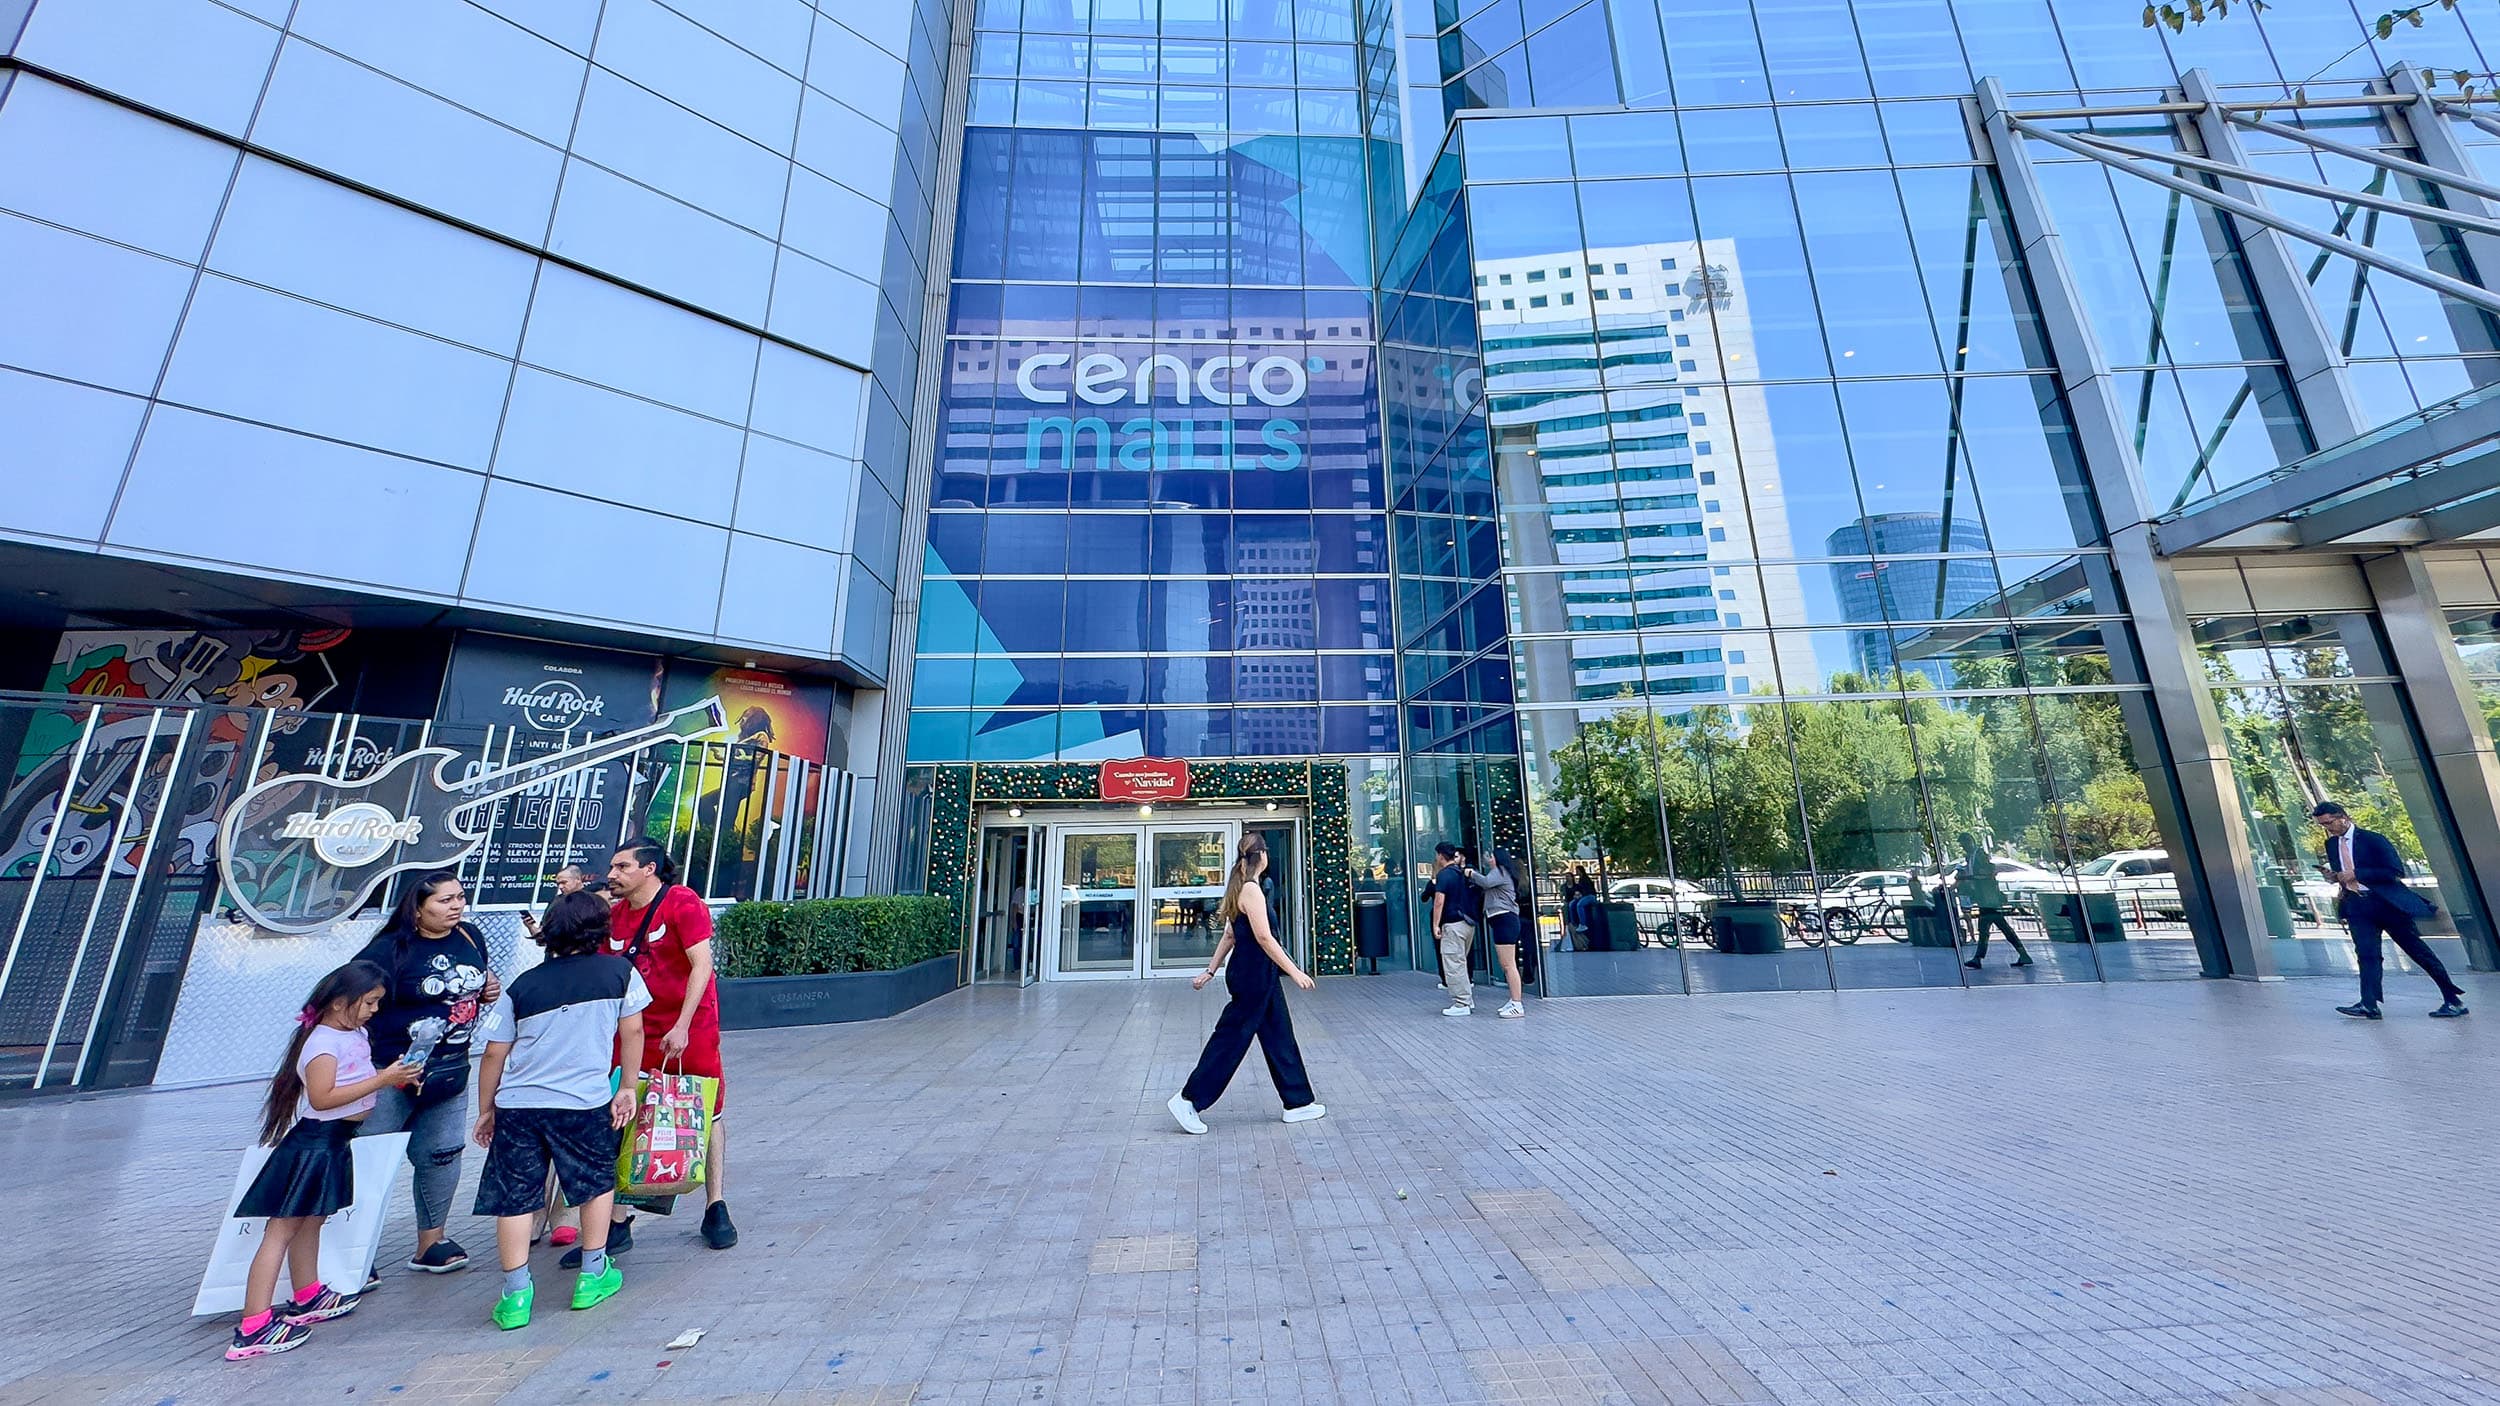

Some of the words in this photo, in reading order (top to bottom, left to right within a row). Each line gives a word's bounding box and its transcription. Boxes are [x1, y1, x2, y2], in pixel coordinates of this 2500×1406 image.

[1016, 353, 1308, 406] cenco
[543, 664, 583, 675] COLABORA
[502, 686, 558, 708] Hard
[557, 691, 605, 716] Rock
[539, 713, 567, 724] CAFE
[1132, 777, 1176, 788] Navidad
[281, 812, 361, 840] Hard
[358, 816, 423, 845] Rock
[771, 991, 831, 1003] COSTANERA
